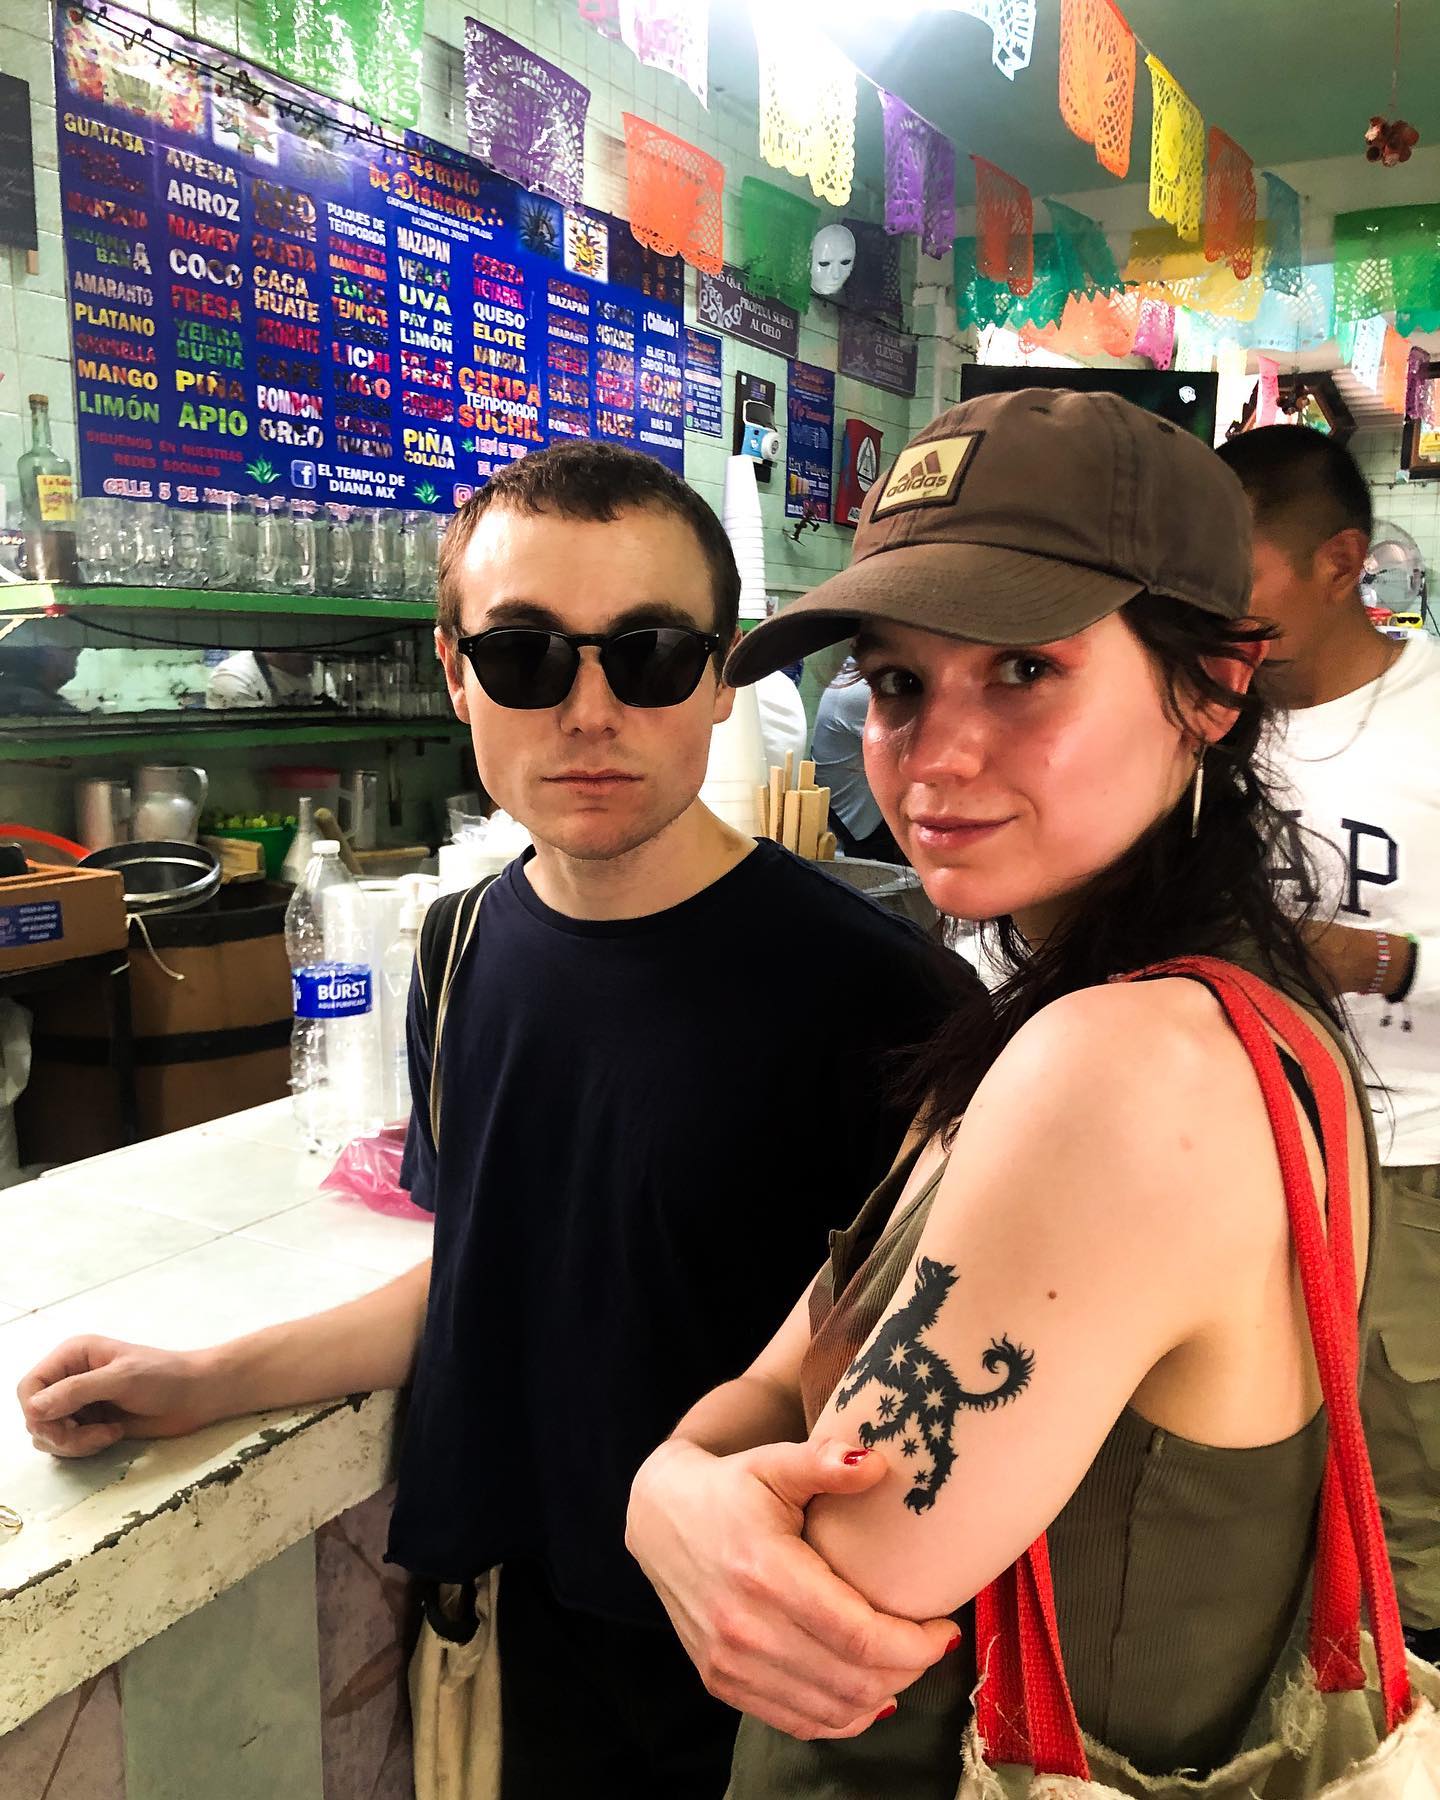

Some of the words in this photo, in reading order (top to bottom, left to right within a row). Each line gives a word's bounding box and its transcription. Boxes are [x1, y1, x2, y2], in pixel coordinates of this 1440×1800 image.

[63, 112, 145, 155] GUAYABA
[167, 149, 238, 189] AVENA
[167, 179, 240, 222] ARROZ
[168, 214, 240, 252] MAMEY
[327, 202, 370, 227] PULQUES
[373, 217, 386, 232] DE
[328, 216, 386, 247] TEMPORADA
[397, 226, 450, 264] MAZAPAN
[169, 248, 244, 290] COCO
[253, 265, 309, 298] CACA
[329, 253, 387, 282] MANDARINA
[75, 271, 153, 307] AMARANTO
[170, 284, 242, 324] FRESA
[399, 283, 452, 316] UVA
[547, 293, 590, 315] MAZAPAN
[74, 302, 155, 337] PLATANO
[254, 288, 320, 323] HUATE
[473, 301, 526, 330] QUESO
[740, 296, 771, 322] PROPINA
[400, 309, 427, 329] PAY
[433, 318, 452, 336] DE
[473, 321, 526, 350] ELOTE
[750, 318, 760, 332] AL
[761, 323, 781, 340] CIELO
[400, 327, 453, 354] LIMÓN
[331, 341, 391, 373] LICHI
[77, 358, 158, 390] MANGO
[175, 369, 246, 402] PIÑA
[401, 364, 453, 390] FRESA
[458, 367, 542, 408] CEMPA
[79, 391, 160, 424] LIMÓN
[257, 385, 323, 420] BOMBON
[464, 390, 538, 422] TEMPORADA
[178, 402, 248, 437] APIO
[259, 418, 324, 449] OREO
[458, 404, 544, 443] SUCHIL
[403, 427, 455, 457] PIÑA
[318, 463, 332, 477] EL
[335, 465, 386, 484] TEMPLO
[389, 473, 405, 487] DE
[404, 450, 455, 470] COLADA
[103, 478, 153, 498] CALLE
[177, 486, 199, 503] DE
[329, 479, 373, 497] DIANA
[376, 485, 396, 500] MX
[886, 474, 949, 498] adidas
[317, 980, 367, 1000] BURST
